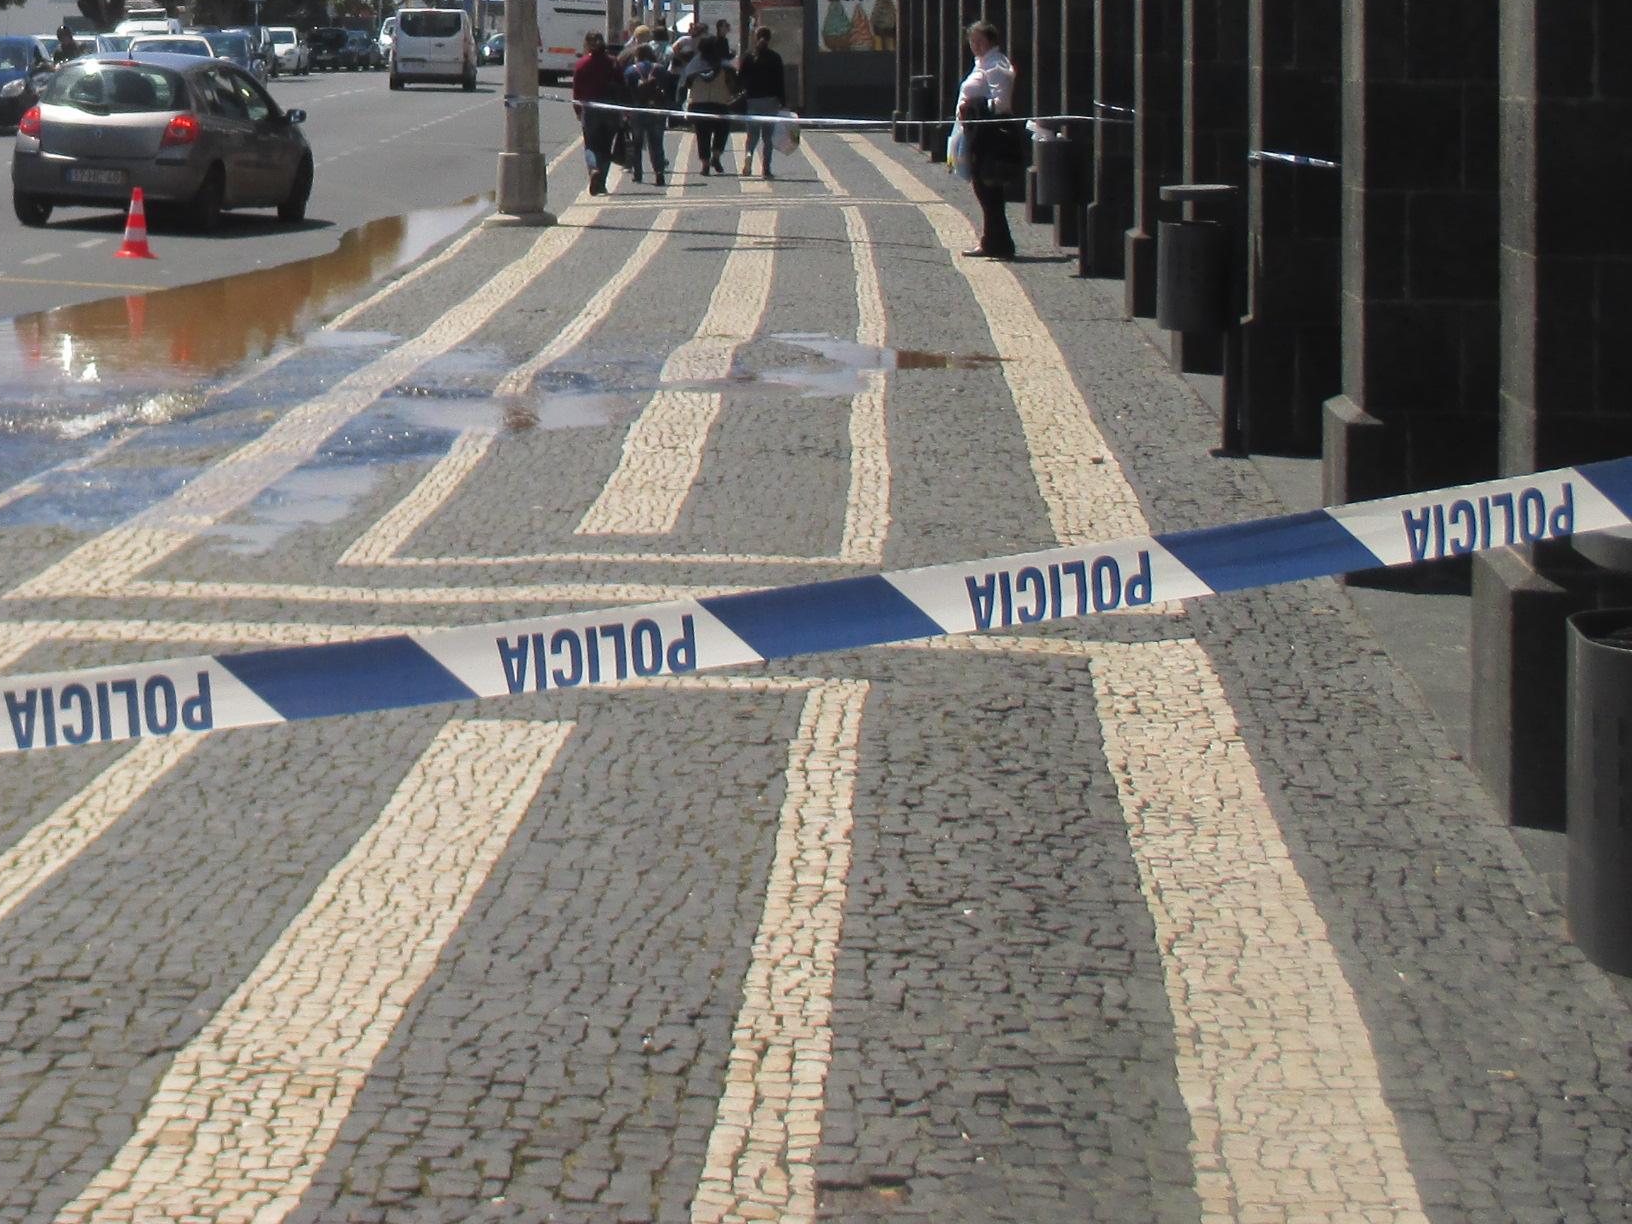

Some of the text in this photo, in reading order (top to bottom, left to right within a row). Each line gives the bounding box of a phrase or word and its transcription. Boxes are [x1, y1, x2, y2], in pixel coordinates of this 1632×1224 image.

[1401, 482, 1574, 563] POLICIA
[964, 550, 1153, 631] POLICIA
[496, 614, 697, 695] POLICIA
[3, 670, 214, 749] POLICIA
